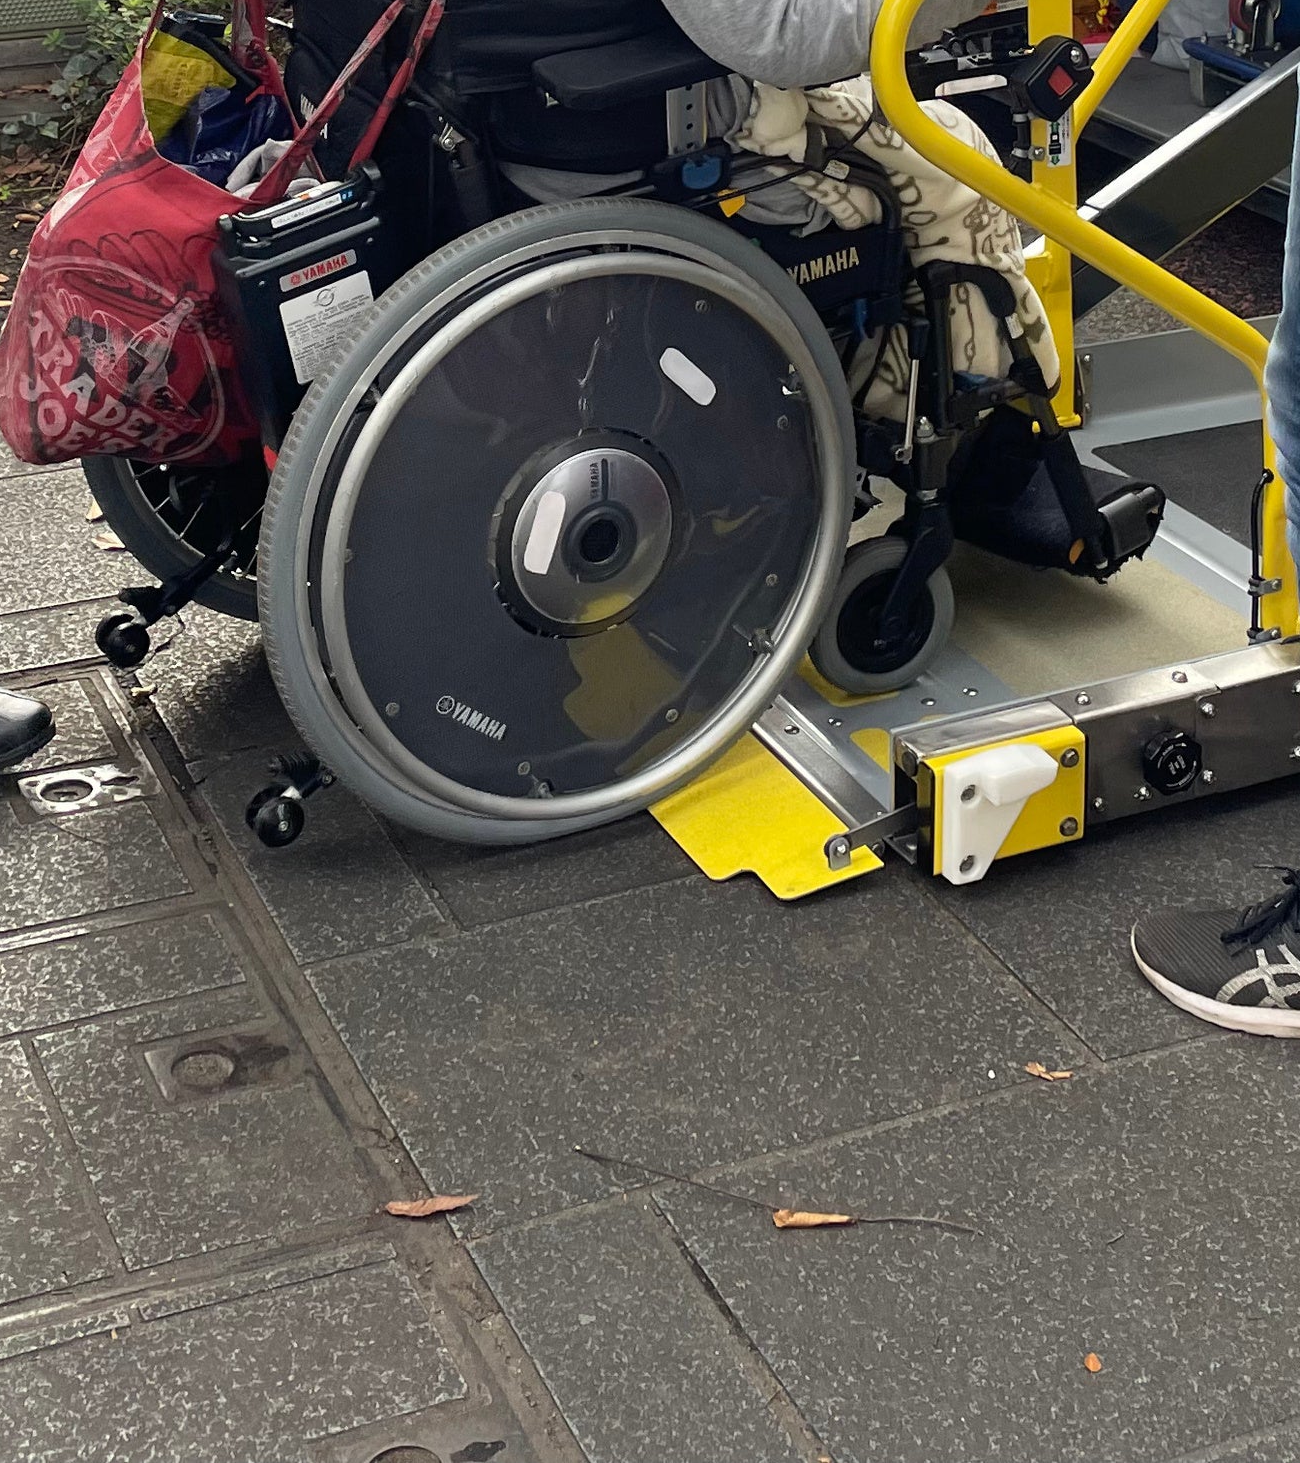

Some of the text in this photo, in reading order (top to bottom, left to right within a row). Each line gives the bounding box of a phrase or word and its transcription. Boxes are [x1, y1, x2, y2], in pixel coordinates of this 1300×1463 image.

[302, 254, 349, 281] YAMAHA
[786, 246, 860, 285] YAMAHA
[451, 702, 507, 741] YAMAHA
